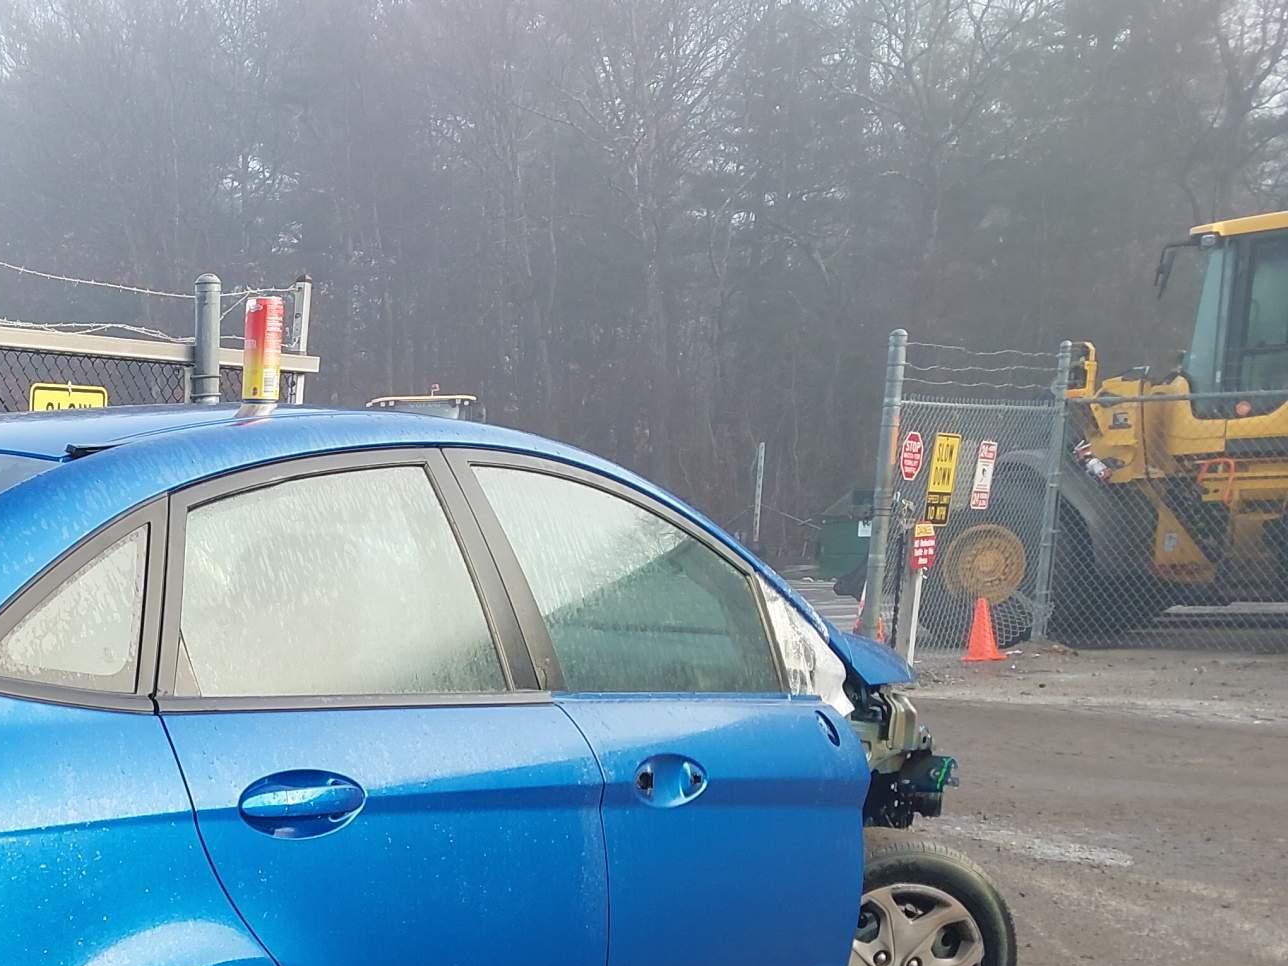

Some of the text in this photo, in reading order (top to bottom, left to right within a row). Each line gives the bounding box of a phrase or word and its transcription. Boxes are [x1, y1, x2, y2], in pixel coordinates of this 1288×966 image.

[906, 440, 921, 452] STOP
[937, 443, 954, 462] SLOW
[932, 466, 952, 486] DOWN
